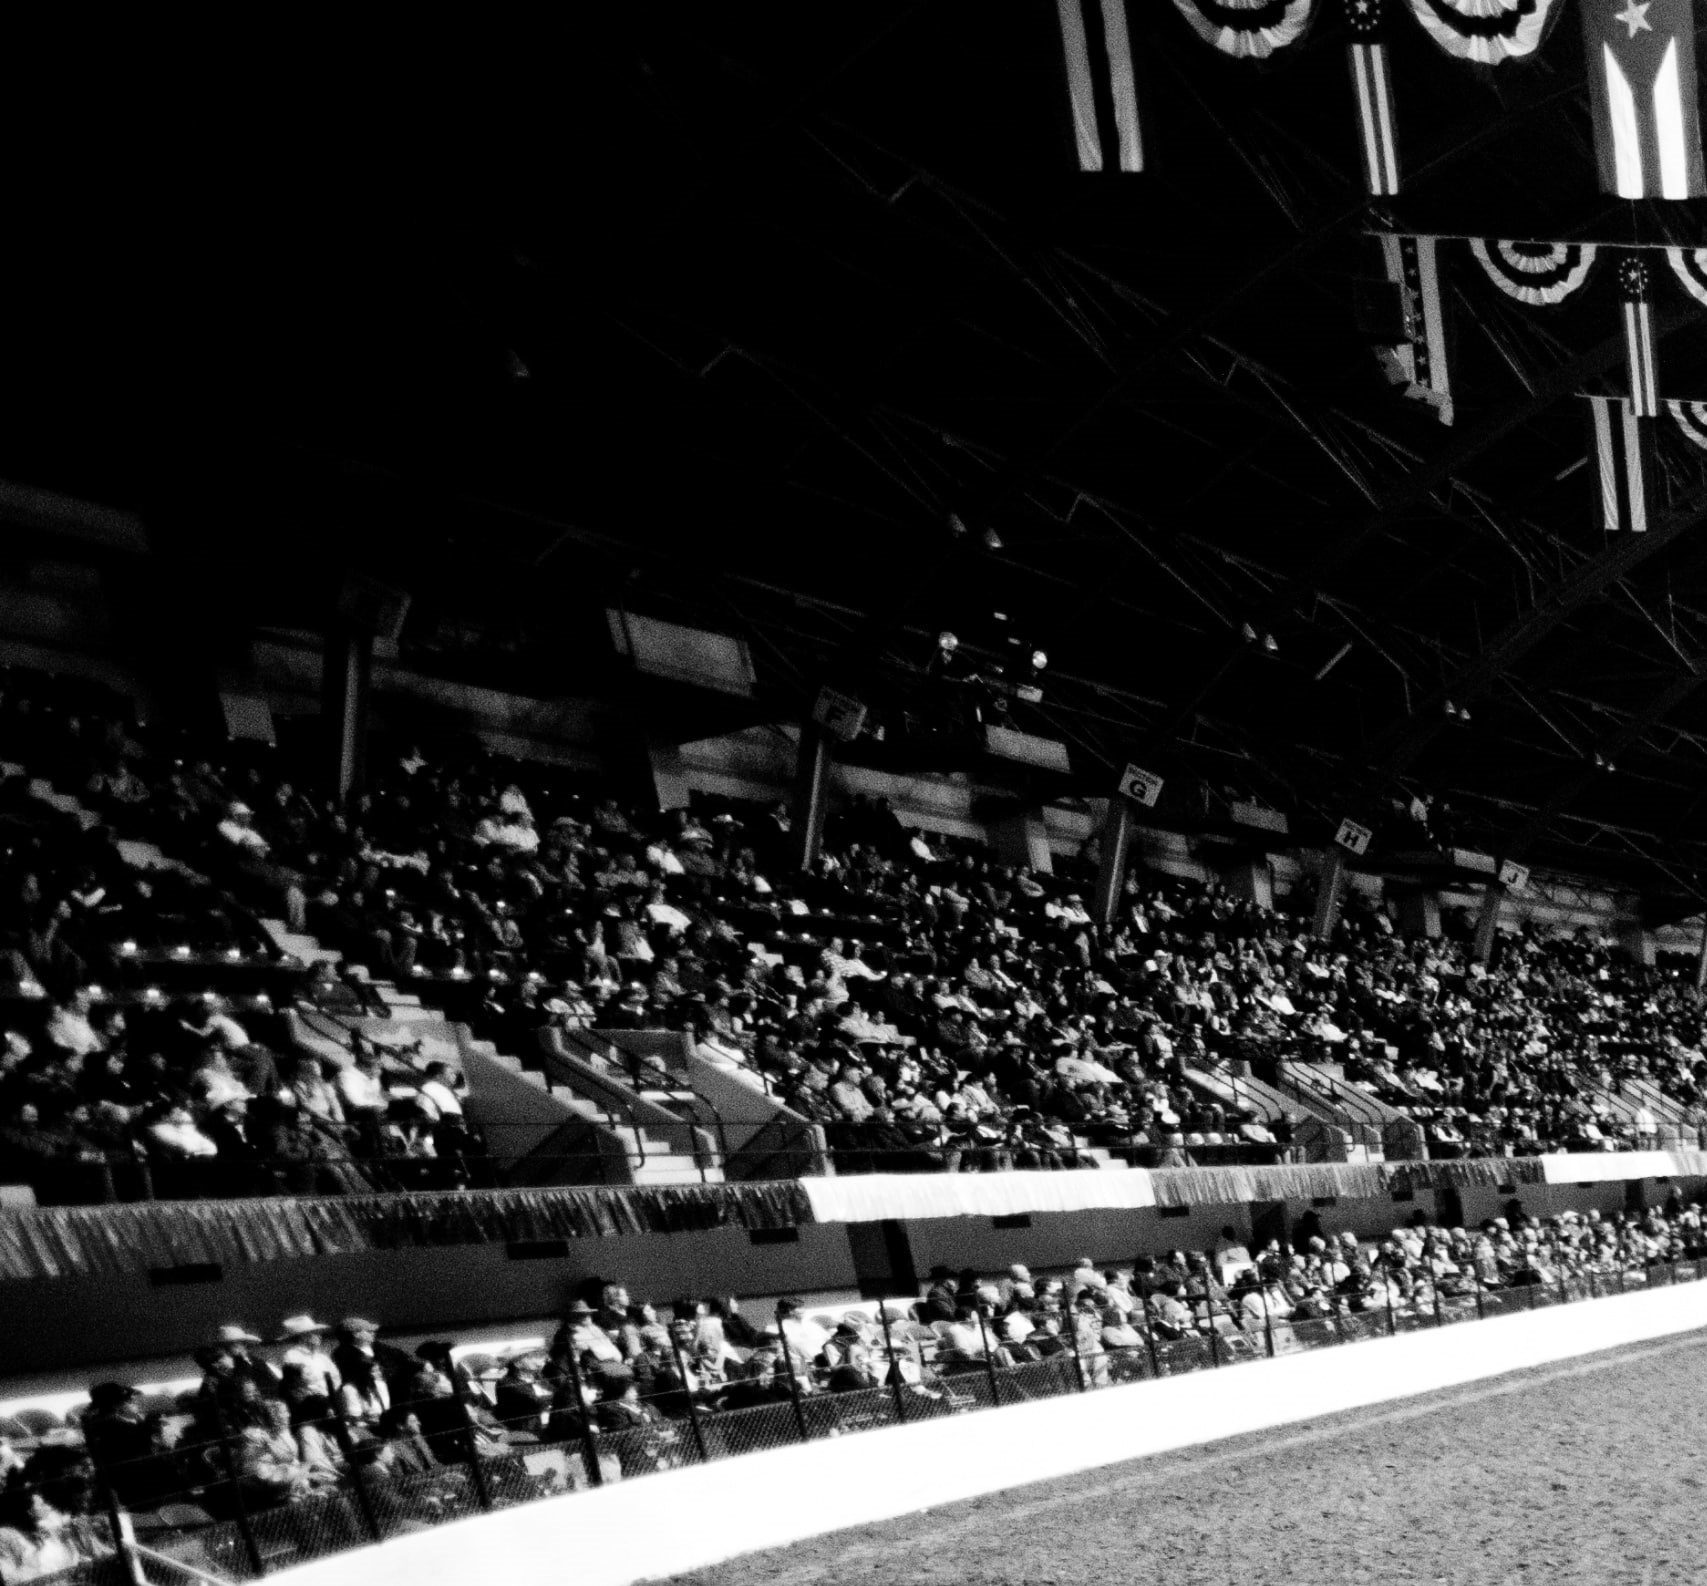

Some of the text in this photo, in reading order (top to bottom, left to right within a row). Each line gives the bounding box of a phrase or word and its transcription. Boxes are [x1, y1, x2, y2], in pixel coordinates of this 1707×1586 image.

[825, 706, 846, 722] F
[1129, 780, 1147, 799] G
[1343, 830, 1359, 847] H
[1507, 872, 1518, 884] J
